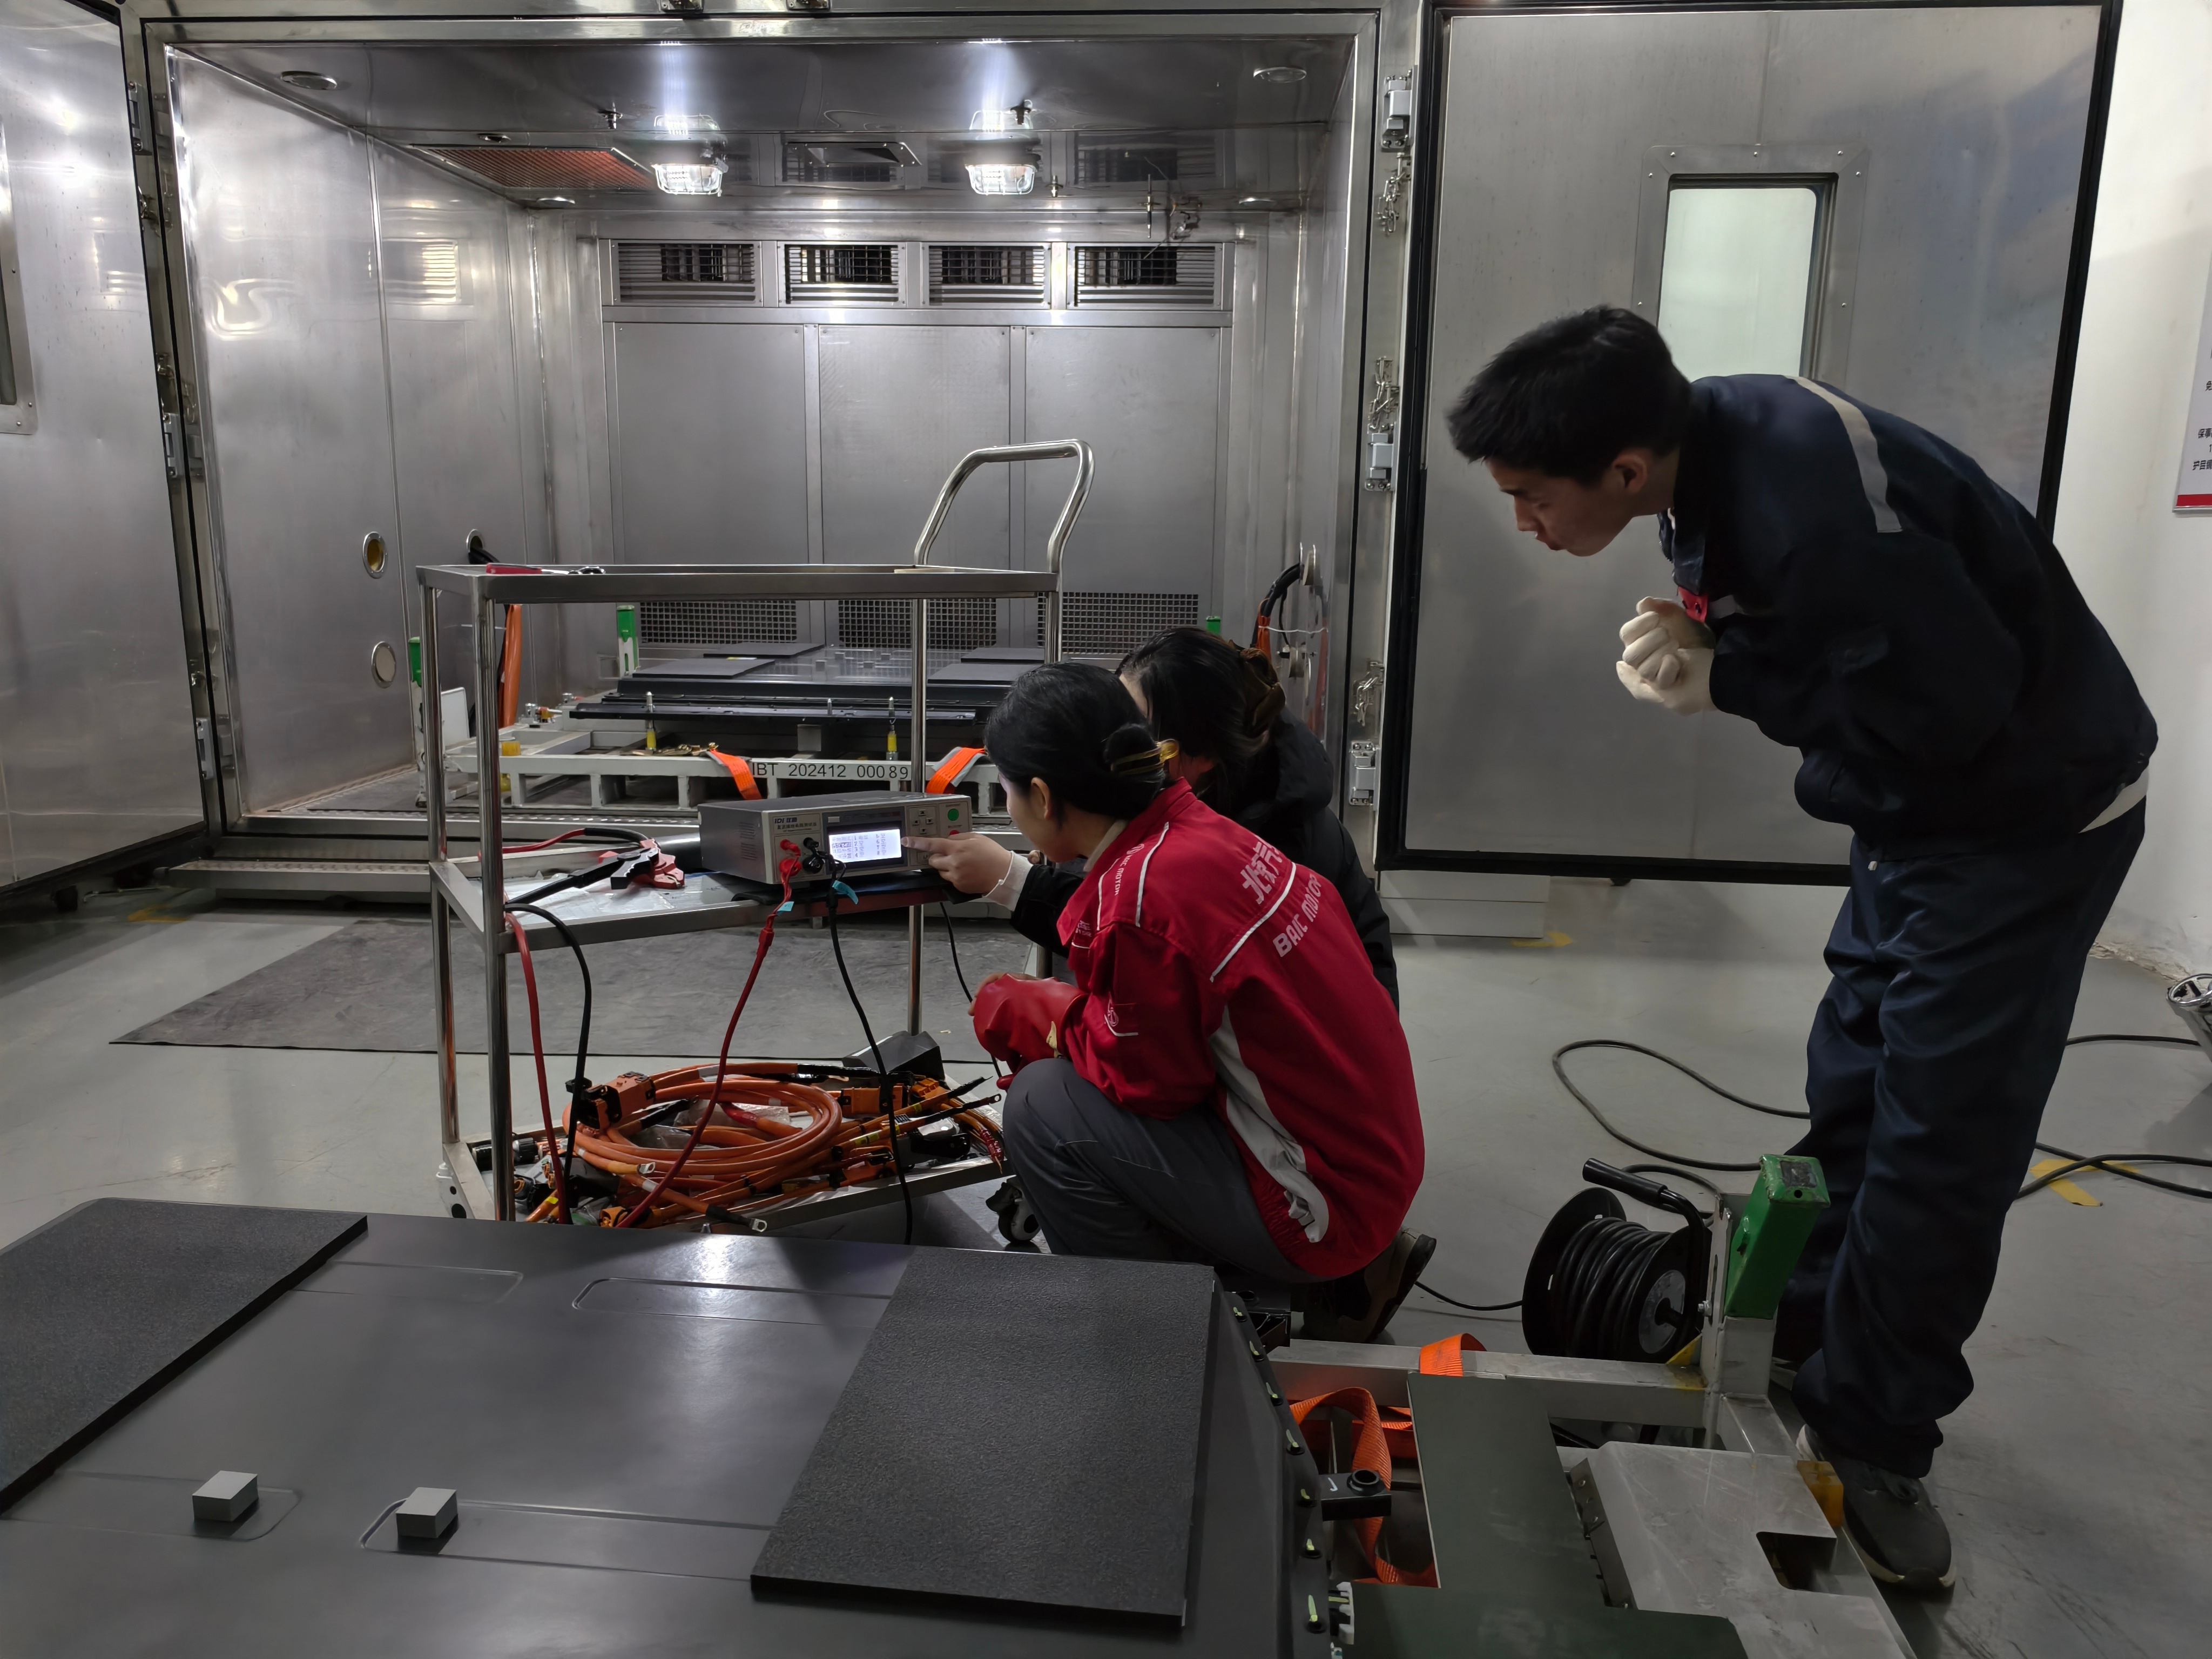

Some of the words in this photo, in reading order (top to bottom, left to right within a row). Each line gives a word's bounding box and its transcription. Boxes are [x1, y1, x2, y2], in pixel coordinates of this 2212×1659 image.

[752, 763, 778, 776] IBT
[788, 764, 846, 777] 202412
[1272, 913, 1308, 958] BAIC
[1301, 873, 1322, 922] MOTOR
